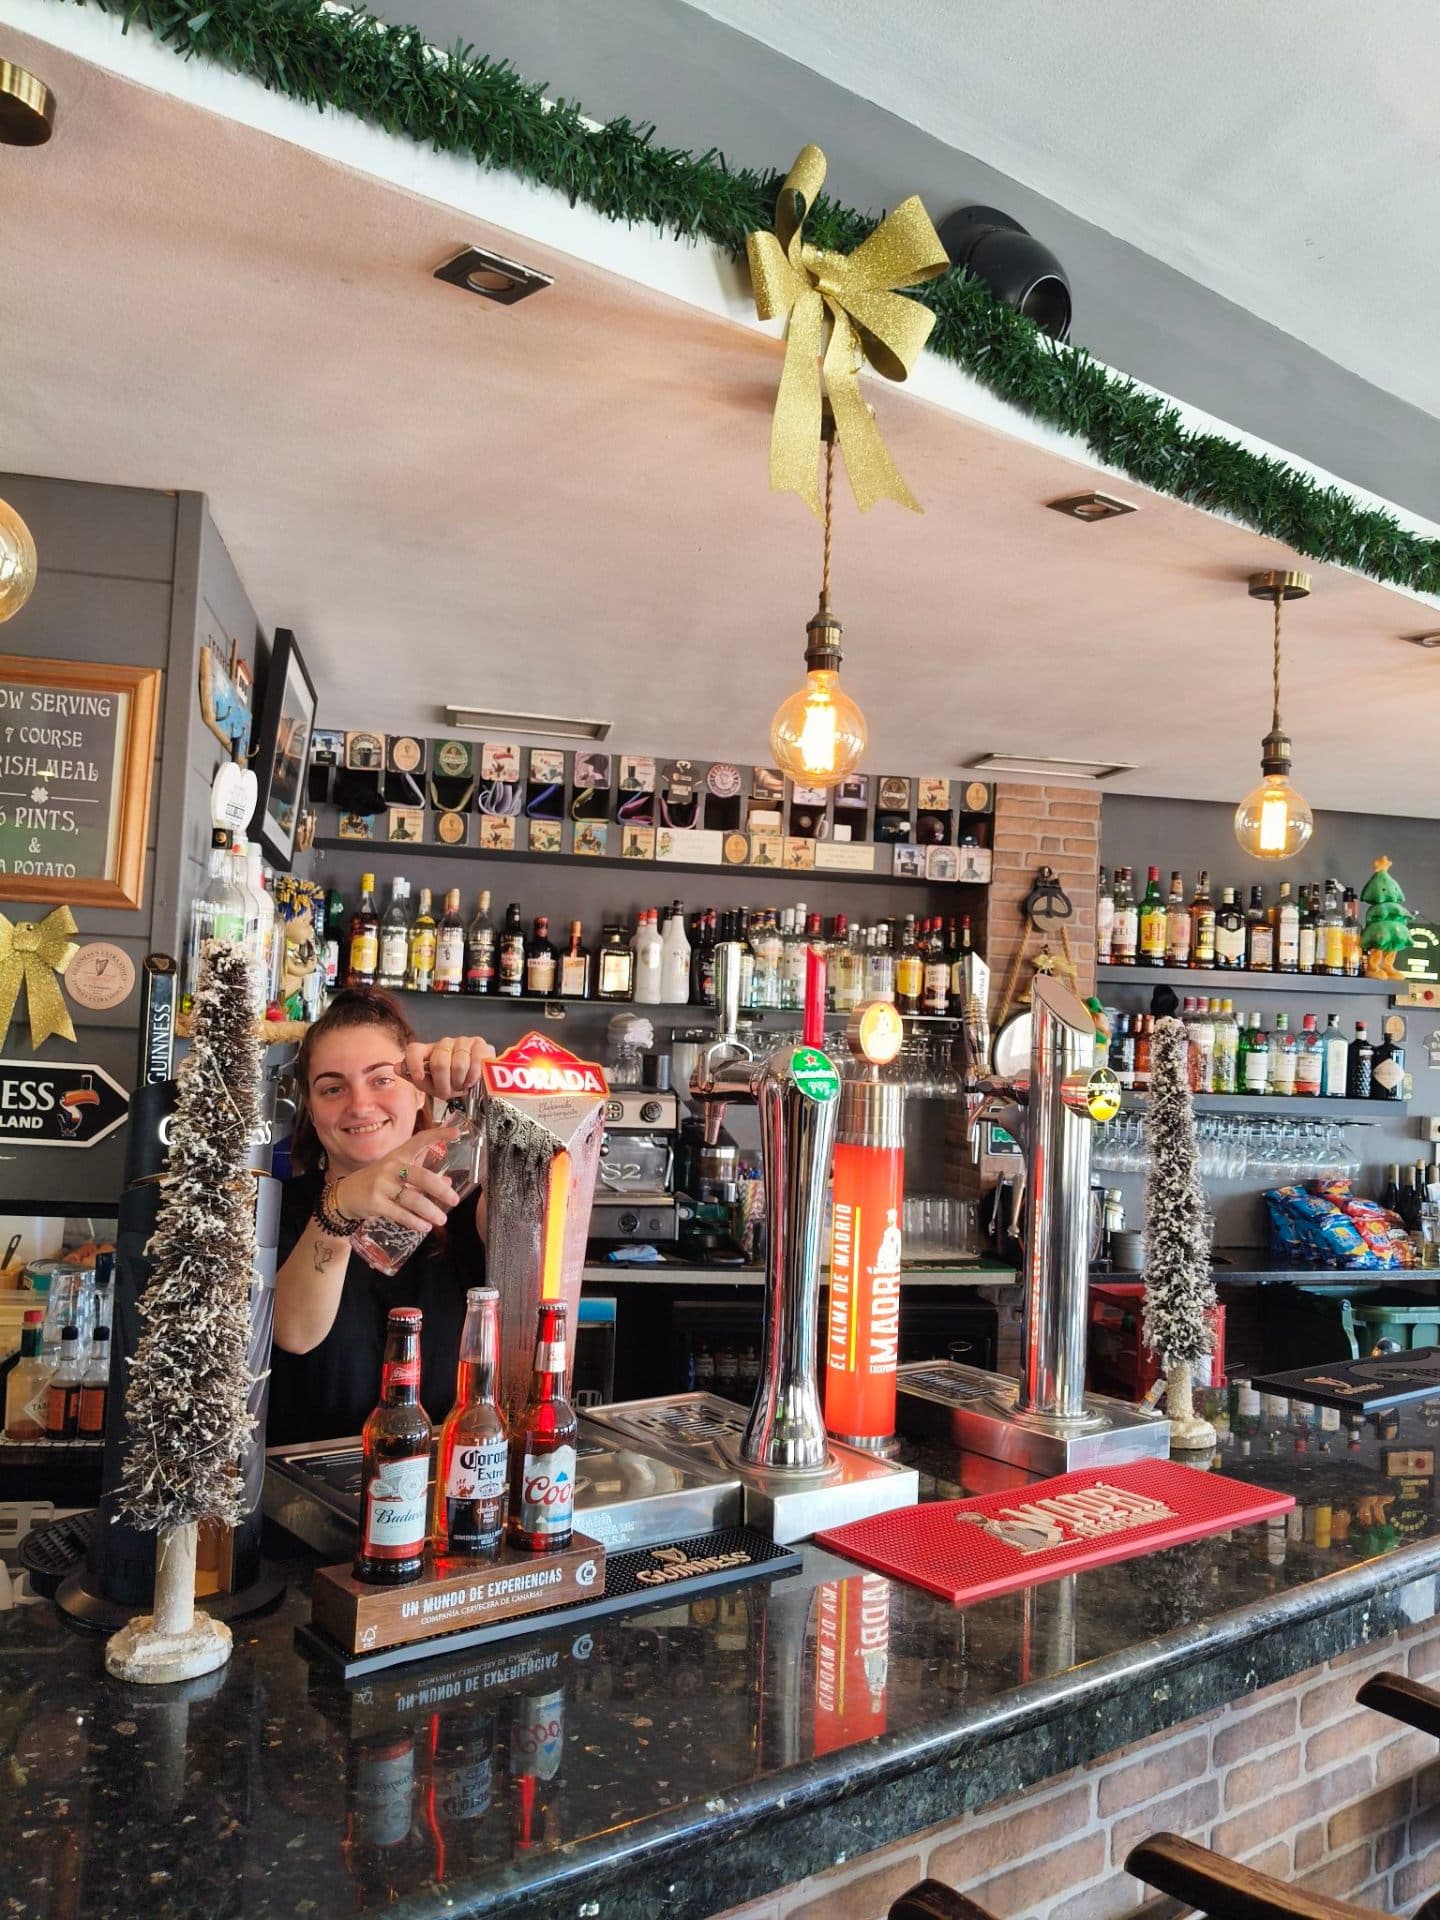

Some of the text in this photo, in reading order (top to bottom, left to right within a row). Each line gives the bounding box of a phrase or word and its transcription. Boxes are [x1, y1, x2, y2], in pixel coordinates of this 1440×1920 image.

[30, 692, 111, 717] SERVING
[5, 726, 83, 748] 7 COURSE
[0, 754, 99, 782] ISH MEAL
[14, 806, 79, 836] PINTS,
[28, 836, 41, 854] &
[14, 859, 76, 879] POTATO
[147, 1004, 171, 1085] GUINNESS
[491, 1064, 603, 1092] DORADA
[829, 1203, 852, 1372] EL ALMA DE MADRID
[460, 1449, 508, 1472] Coron
[525, 1475, 573, 1506] Coo
[635, 1550, 752, 1585] GUINNESS
[402, 1567, 564, 1618] UN MUNDO DE EXPERIENCIAS
[461, 1600, 500, 1616] CERVECERA
[500, 1597, 511, 1607] DE
[511, 1590, 545, 1604] CANARIAS
